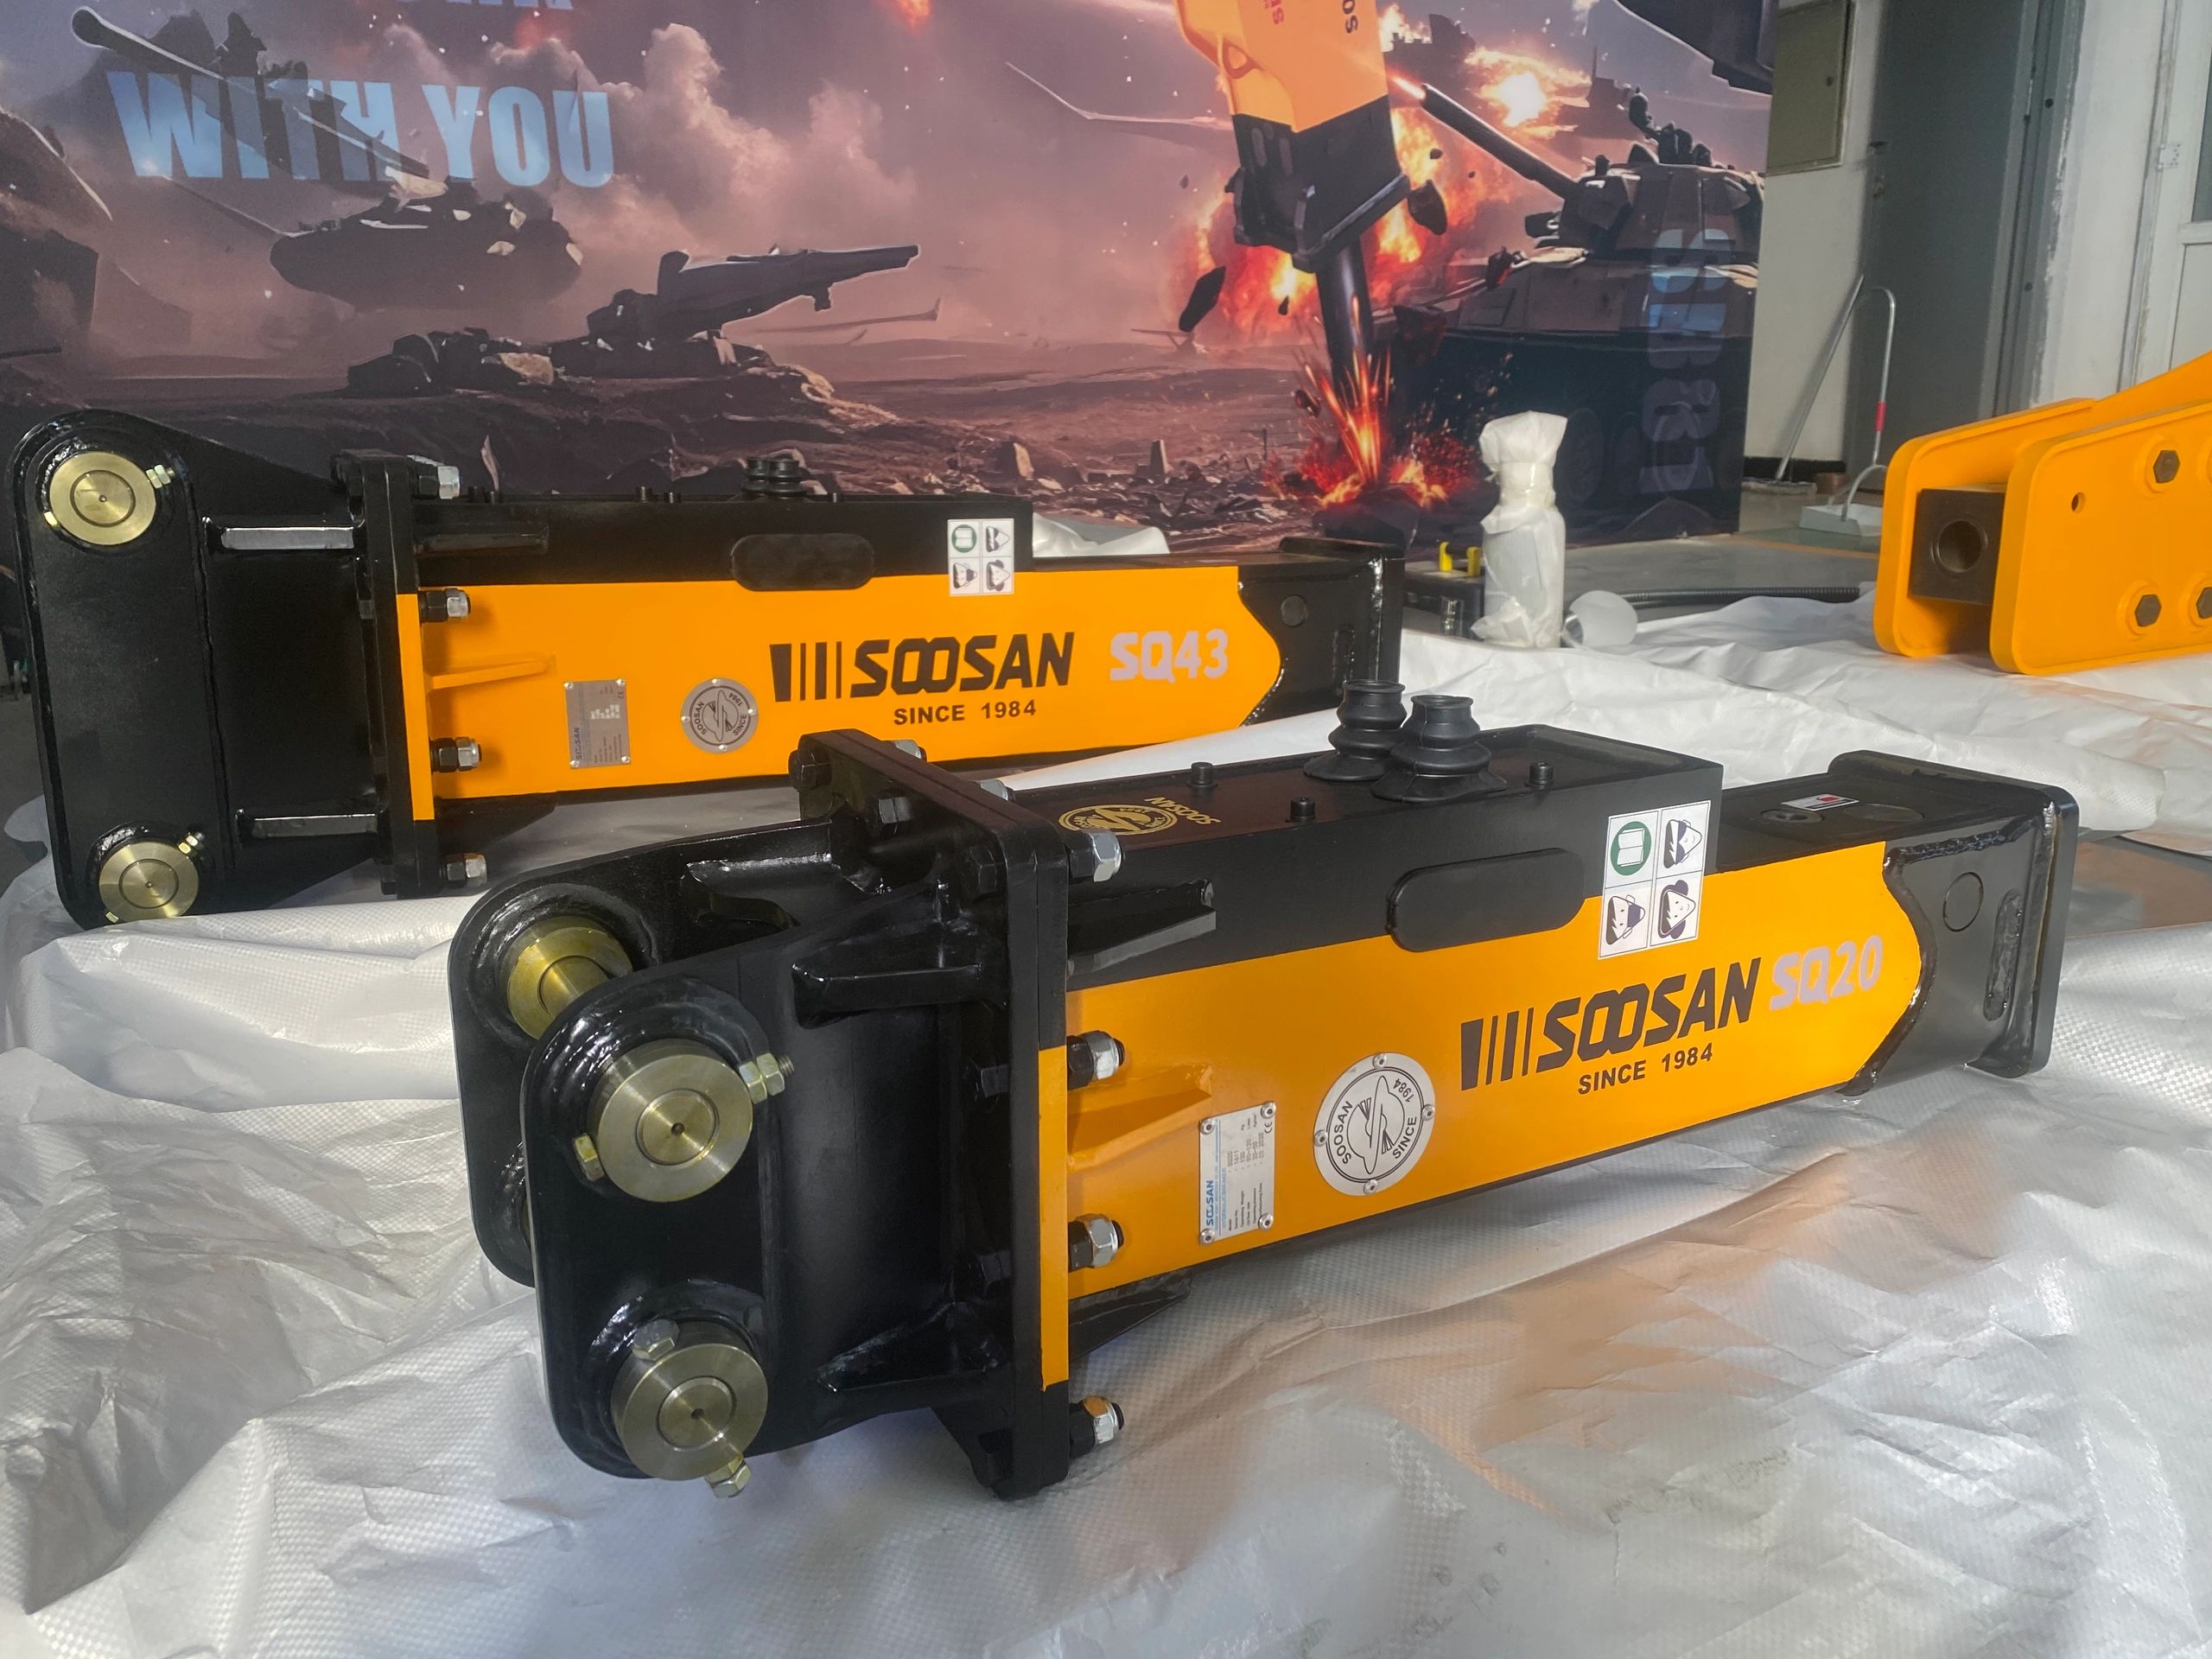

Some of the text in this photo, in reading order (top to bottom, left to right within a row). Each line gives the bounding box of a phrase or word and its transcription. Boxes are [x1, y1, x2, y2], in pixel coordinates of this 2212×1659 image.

[107, 71, 615, 188] WITH YOU
[850, 629, 1229, 698] SOOSAN SQ43
[694, 701, 707, 735] SOOSAN
[728, 693, 747, 736] SINCE 1984
[893, 700, 1037, 725] SINCE 1984
[1144, 797, 1222, 824] SOOSAN
[1535, 936, 1884, 1074] SOOSAN SQ20
[1578, 1042, 1713, 1095] SINCE 1984
[1264, 1122, 1272, 1134] CE
[1333, 1101, 1353, 1165] SOOSAN
[1392, 1078, 1417, 1160] SINCE 1984
